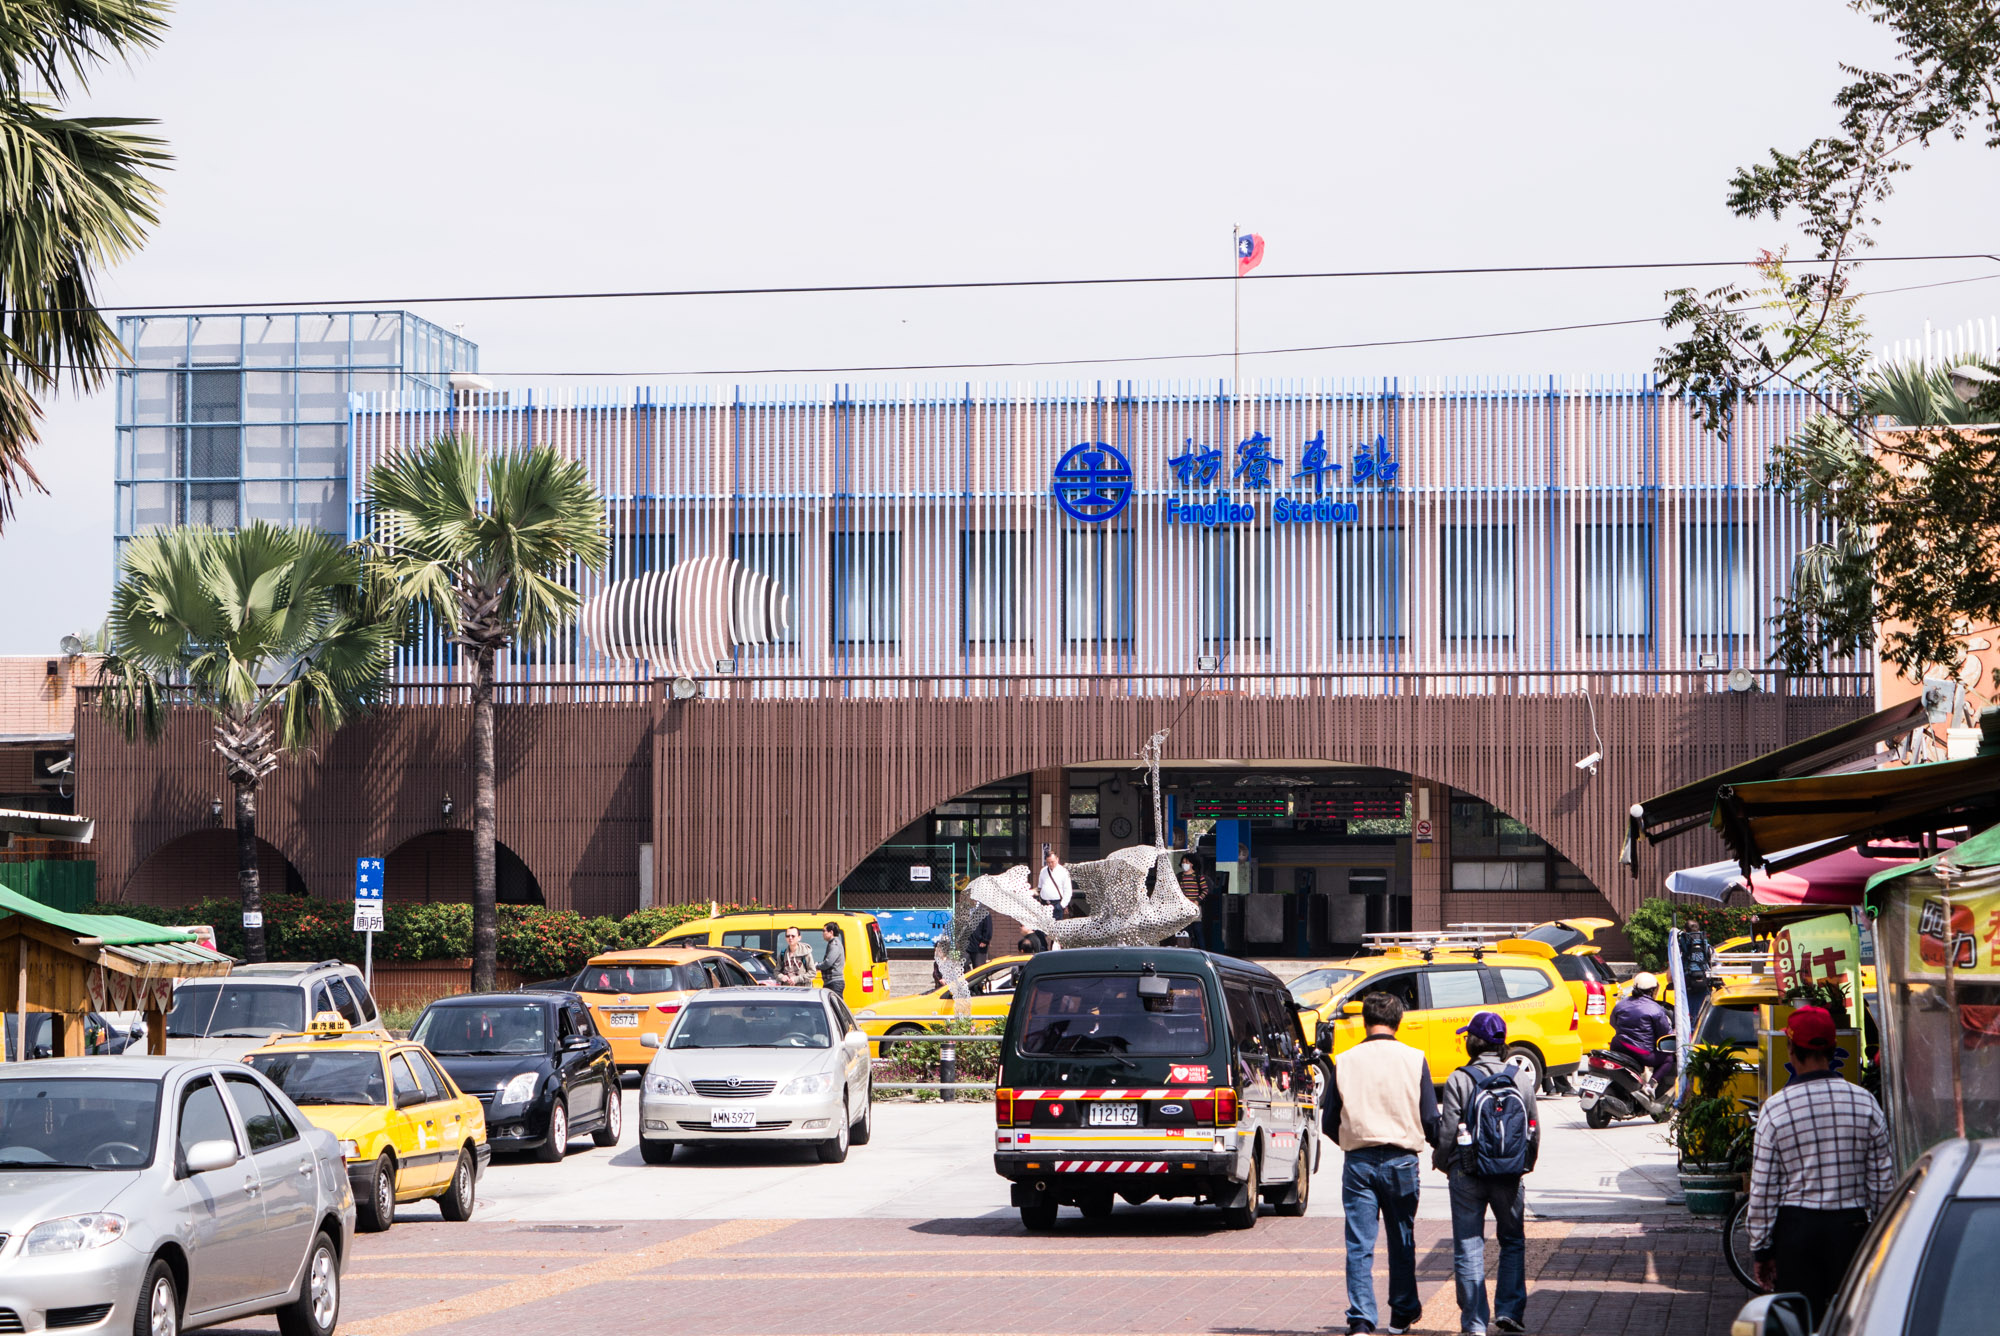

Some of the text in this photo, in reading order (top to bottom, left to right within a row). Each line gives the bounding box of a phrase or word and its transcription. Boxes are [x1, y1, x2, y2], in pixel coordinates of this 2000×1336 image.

[1168, 430, 1400, 494] 枋寮車站
[1167, 496, 1358, 526] Fangliao Station
